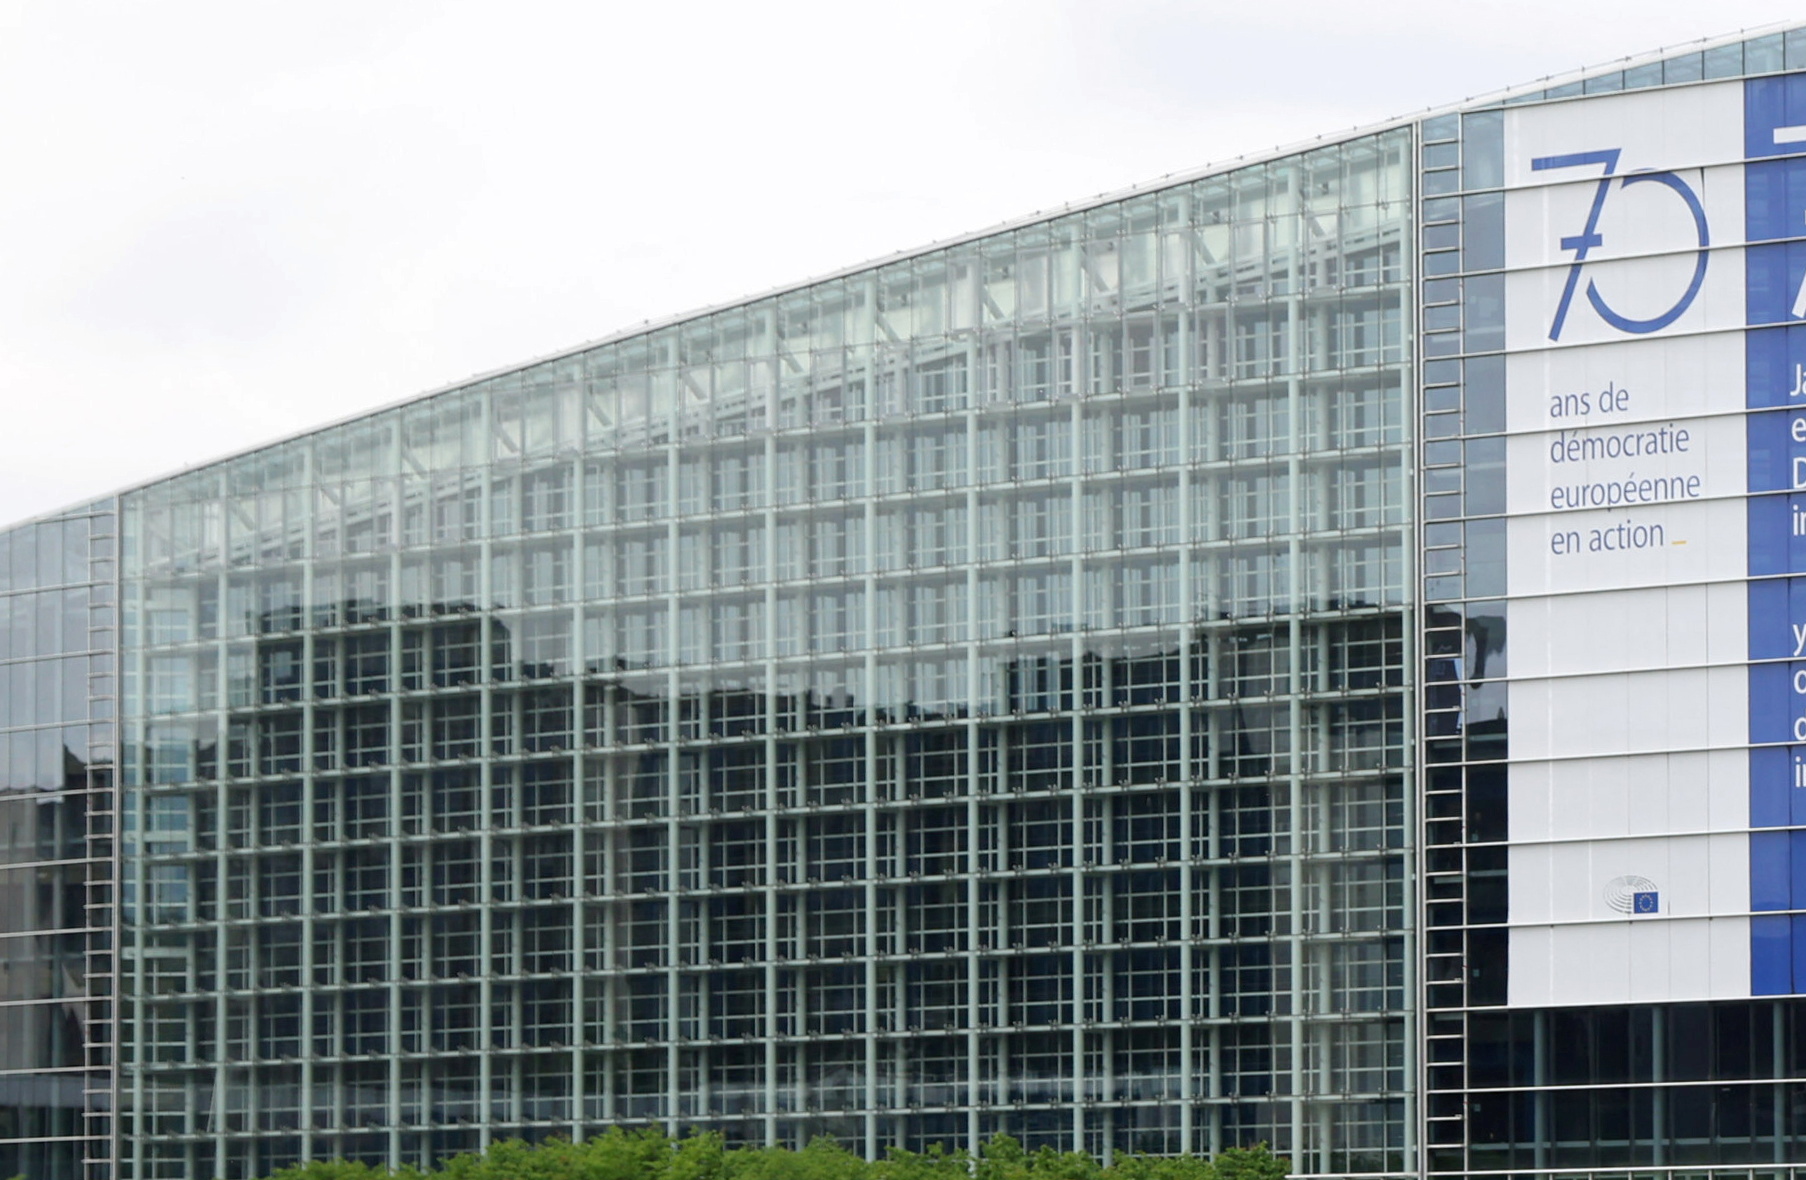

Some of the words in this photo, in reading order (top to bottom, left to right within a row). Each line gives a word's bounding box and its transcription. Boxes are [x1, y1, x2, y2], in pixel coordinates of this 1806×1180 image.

[1550, 391, 1590, 418] ans
[1599, 381, 1630, 413] de
[1550, 424, 1690, 463] démocratie
[1550, 473, 1700, 512] européenne
[1550, 530, 1581, 555] en
[1588, 519, 1664, 551] action
